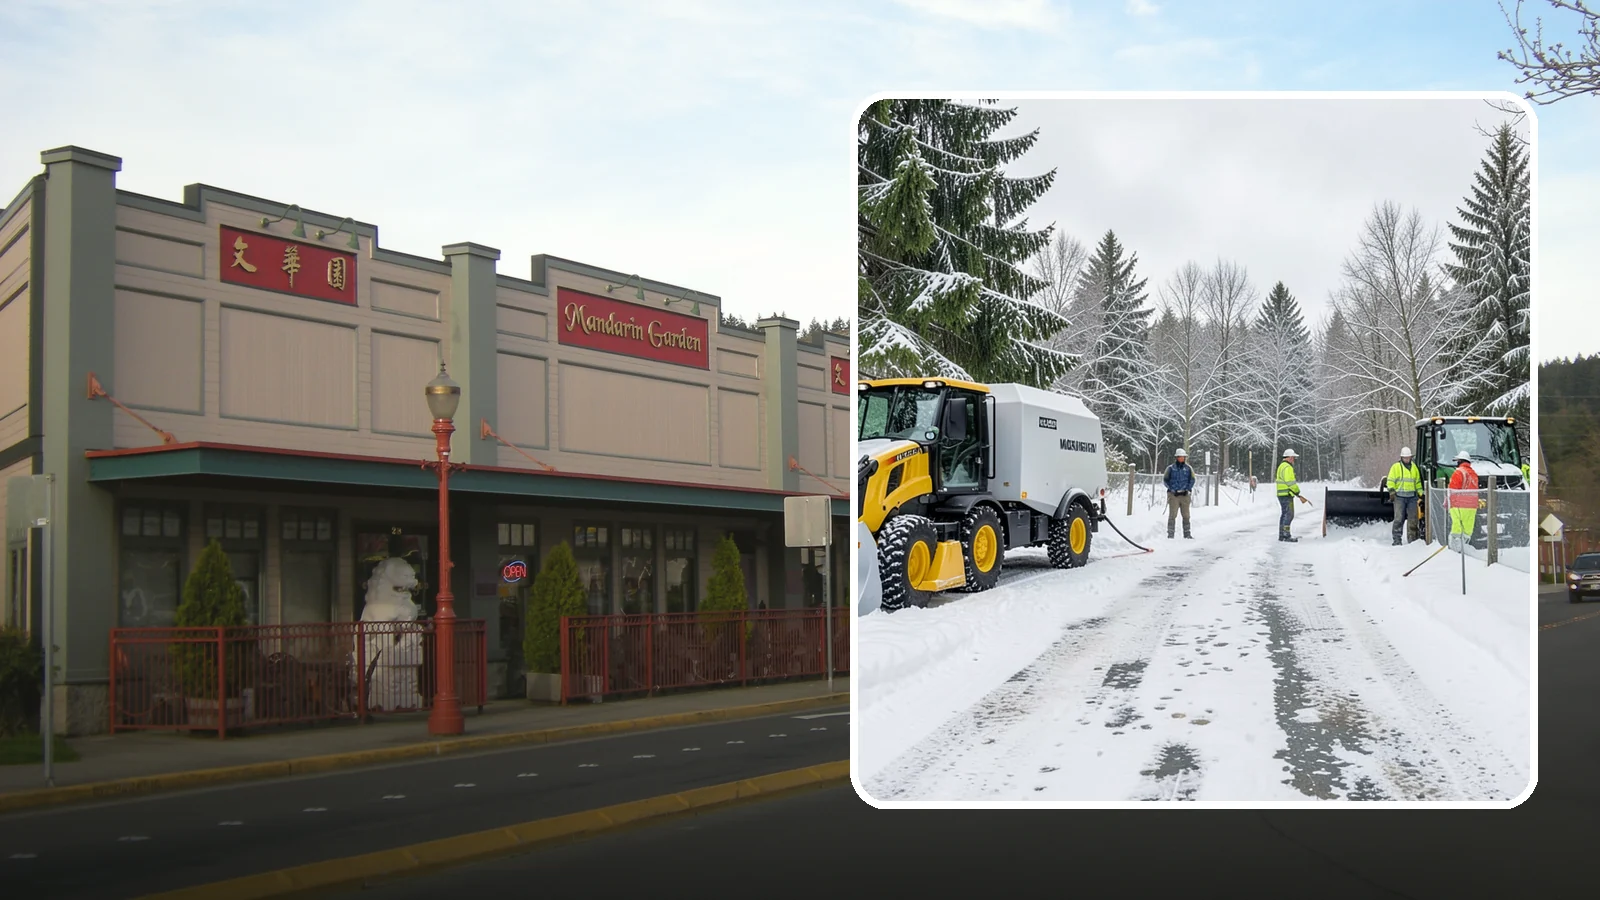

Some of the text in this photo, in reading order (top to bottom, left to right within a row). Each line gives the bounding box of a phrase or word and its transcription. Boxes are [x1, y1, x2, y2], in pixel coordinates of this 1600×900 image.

[230, 235, 346, 291] 文華園
[564, 302, 702, 352] Mandarin Garden
[503, 565, 527, 578] OPEN
